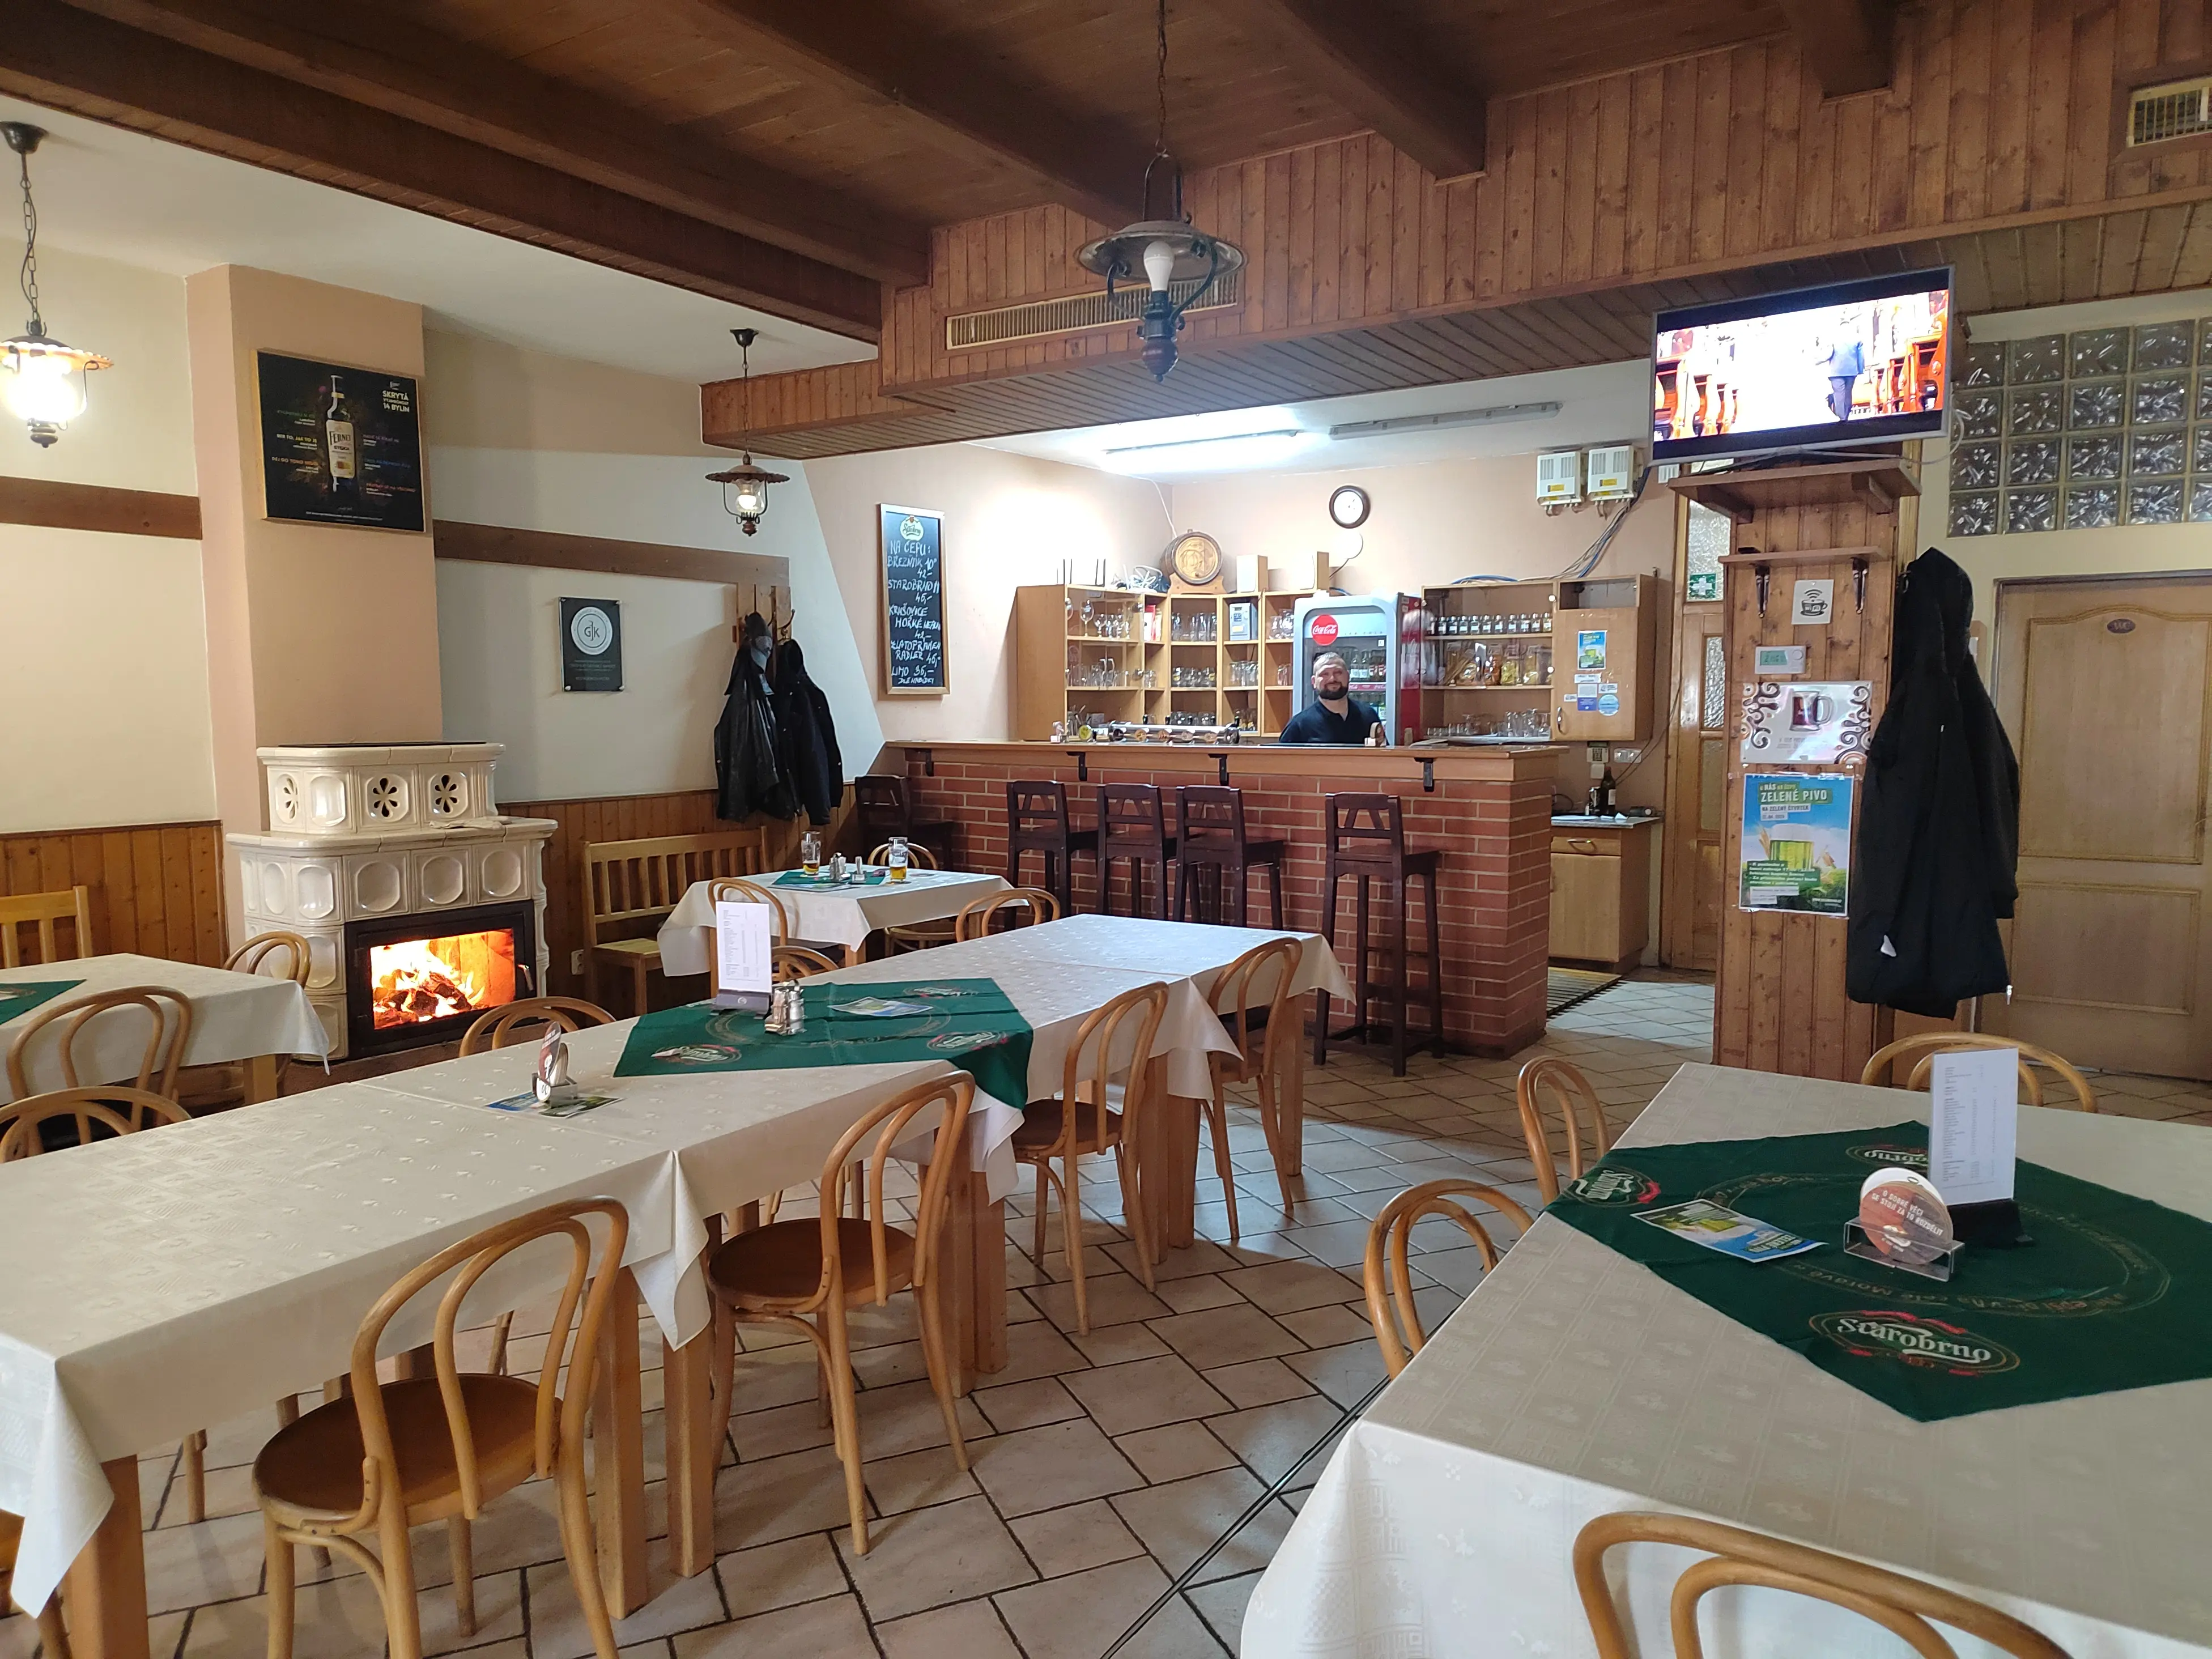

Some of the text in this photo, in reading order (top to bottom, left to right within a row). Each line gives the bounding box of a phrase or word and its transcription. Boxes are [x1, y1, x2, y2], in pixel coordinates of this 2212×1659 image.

[382, 390, 409, 401] SKRYTÁ
[391, 403, 410, 412] BYLIN
[890, 539, 901, 555] NA
[888, 579, 933, 592] STAROBRNO
[889, 603, 929, 616] KRUŠOVICE
[895, 650, 924, 661] RADLER
[891, 666, 909, 677] LIMO
[1761, 789, 1827, 802] ZELENÉ PIVO
[1888, 1193, 1909, 1208] DOBRÉ
[1909, 1202, 1924, 1216] VĚCI
[1871, 1193, 1945, 1237] SE STOJÍ ZA TO ROZDĚLIT
[1836, 1317, 1992, 1364] Starobrno
